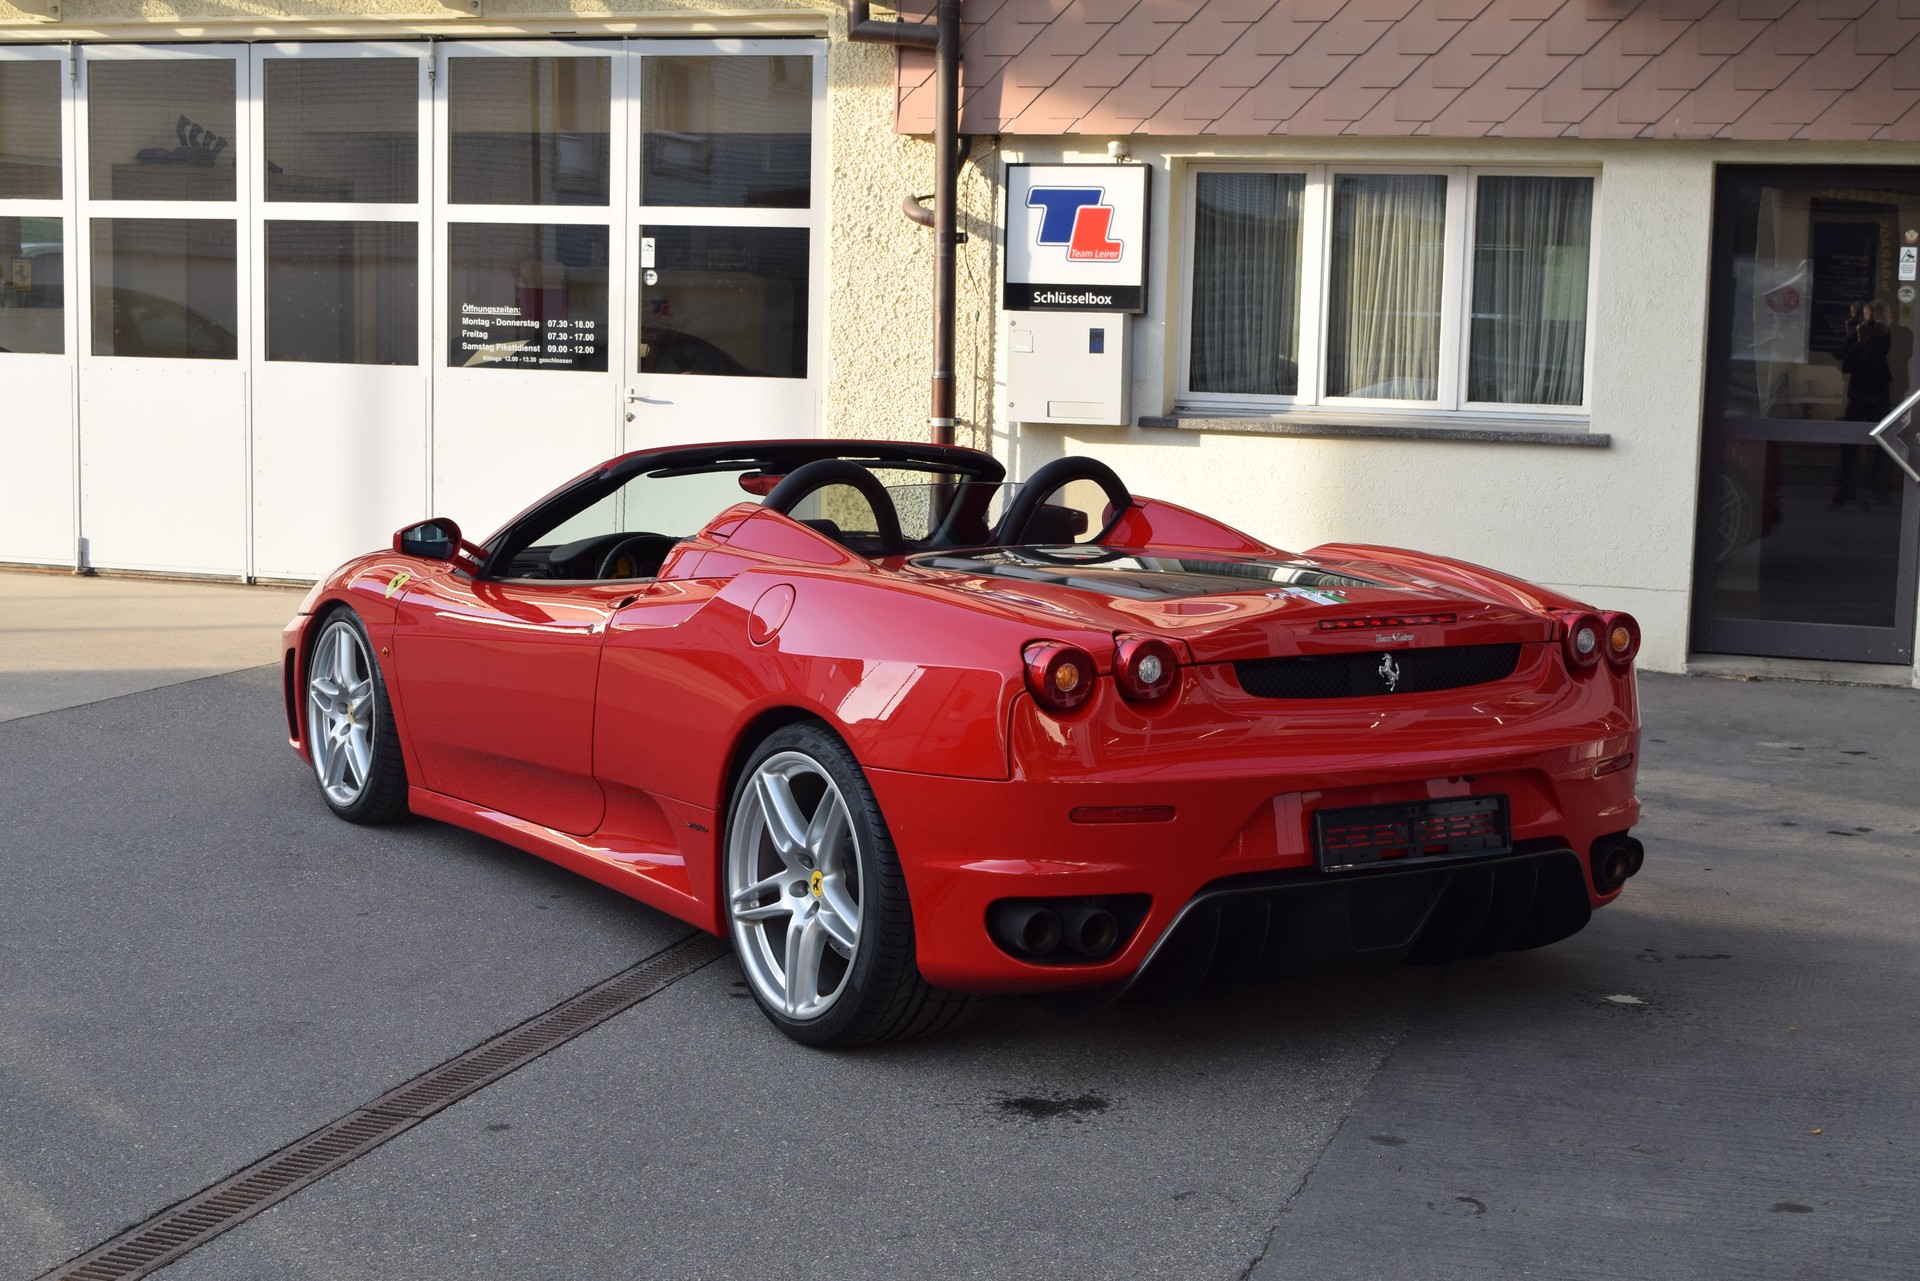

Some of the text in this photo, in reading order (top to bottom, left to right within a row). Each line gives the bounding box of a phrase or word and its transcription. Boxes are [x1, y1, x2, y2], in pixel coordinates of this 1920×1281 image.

[1071, 248, 1119, 259] Team Leirer
[1033, 291, 1112, 305] Schlüsselbox
[462, 303, 521, 315] Öffnungszeiten:
[462, 318, 490, 327] Montag
[496, 318, 540, 328] Donnerstag
[547, 320, 568, 328] 07.30
[574, 320, 595, 329] 18.00
[462, 330, 488, 339] Freitag
[547, 332, 568, 341] 07.30
[574, 333, 595, 341] 17.00
[462, 342, 494, 352] Samstag
[496, 344, 541, 353] Pikettdienst
[547, 345, 568, 353] 09.00
[574, 345, 595, 354] 12.00
